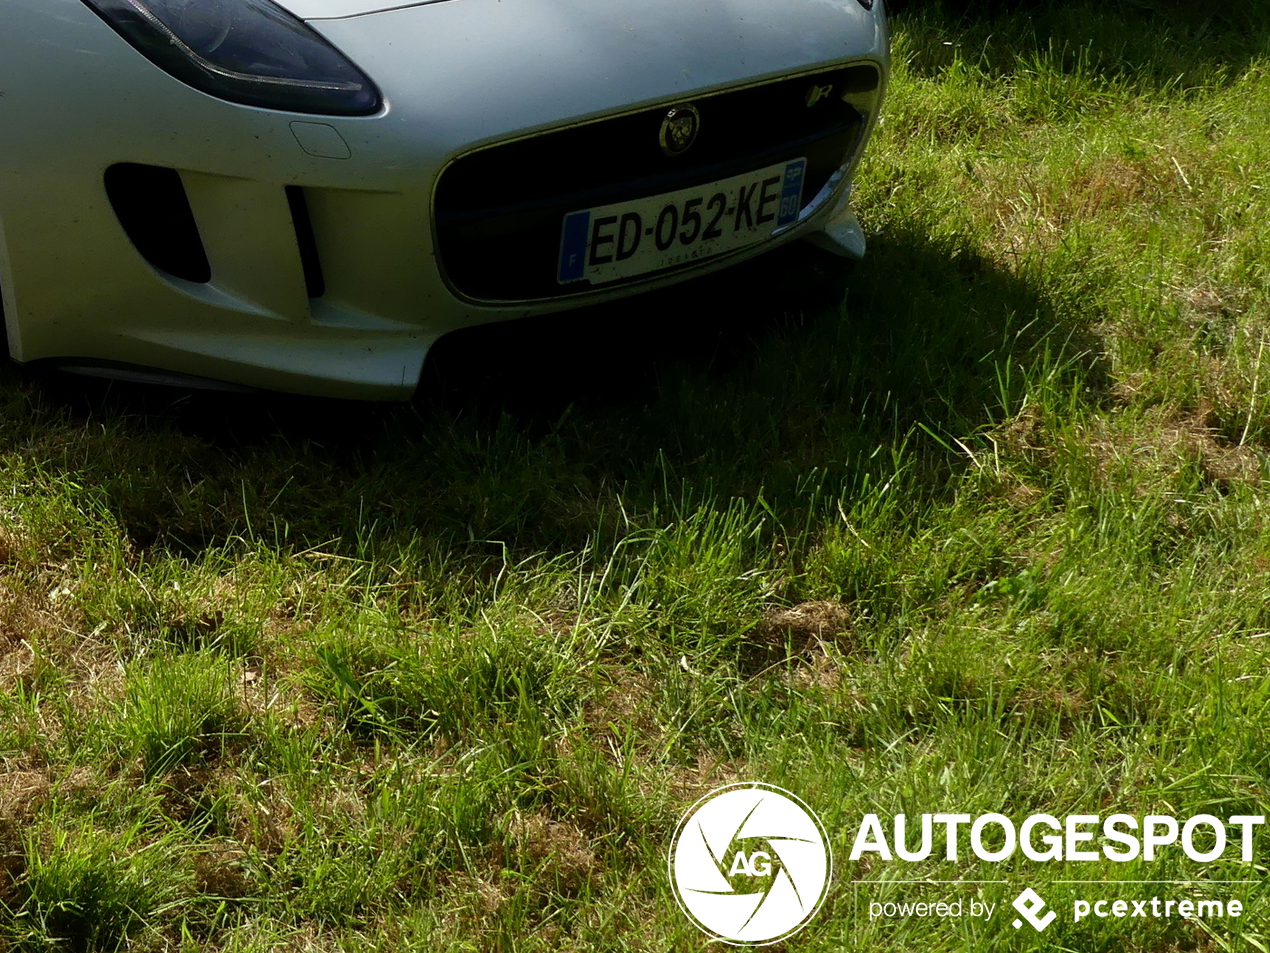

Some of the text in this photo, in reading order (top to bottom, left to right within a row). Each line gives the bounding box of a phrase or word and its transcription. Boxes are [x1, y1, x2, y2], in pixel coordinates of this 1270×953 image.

[780, 195, 797, 217] 60
[588, 176, 781, 266] ED-052-KE
[569, 254, 578, 268] F
